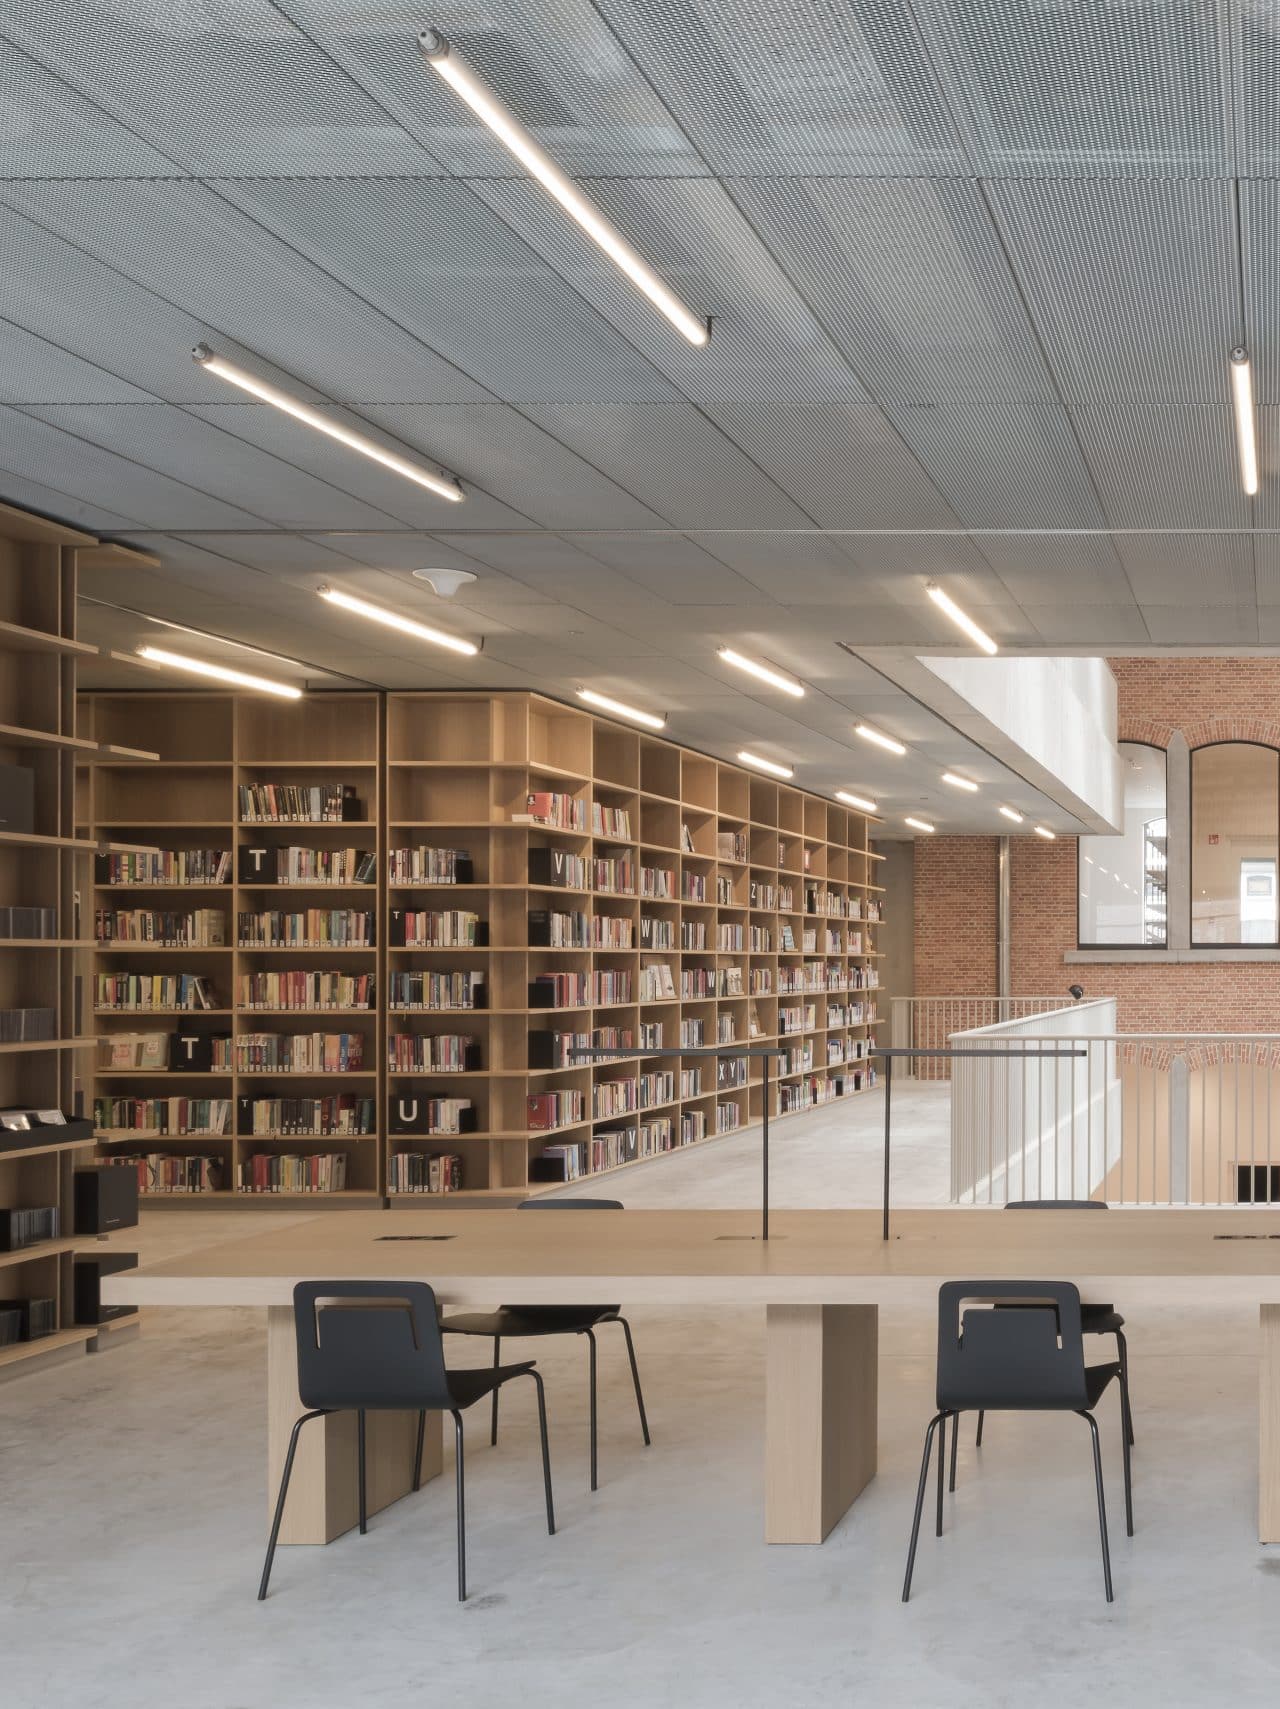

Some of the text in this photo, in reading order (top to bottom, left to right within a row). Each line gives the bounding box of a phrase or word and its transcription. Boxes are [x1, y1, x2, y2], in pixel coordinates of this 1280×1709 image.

[249, 849, 267, 871] T
[555, 852, 563, 874] V
[751, 883, 756, 898] Z
[393, 911, 400, 920] T
[641, 919, 651, 938] W
[707, 970, 715, 988] W
[181, 1037, 199, 1059] T
[719, 1063, 724, 1080] X
[730, 1062, 735, 1078] Y
[241, 1099, 248, 1107] T
[400, 1100, 417, 1121] U
[629, 1130, 636, 1150] V
